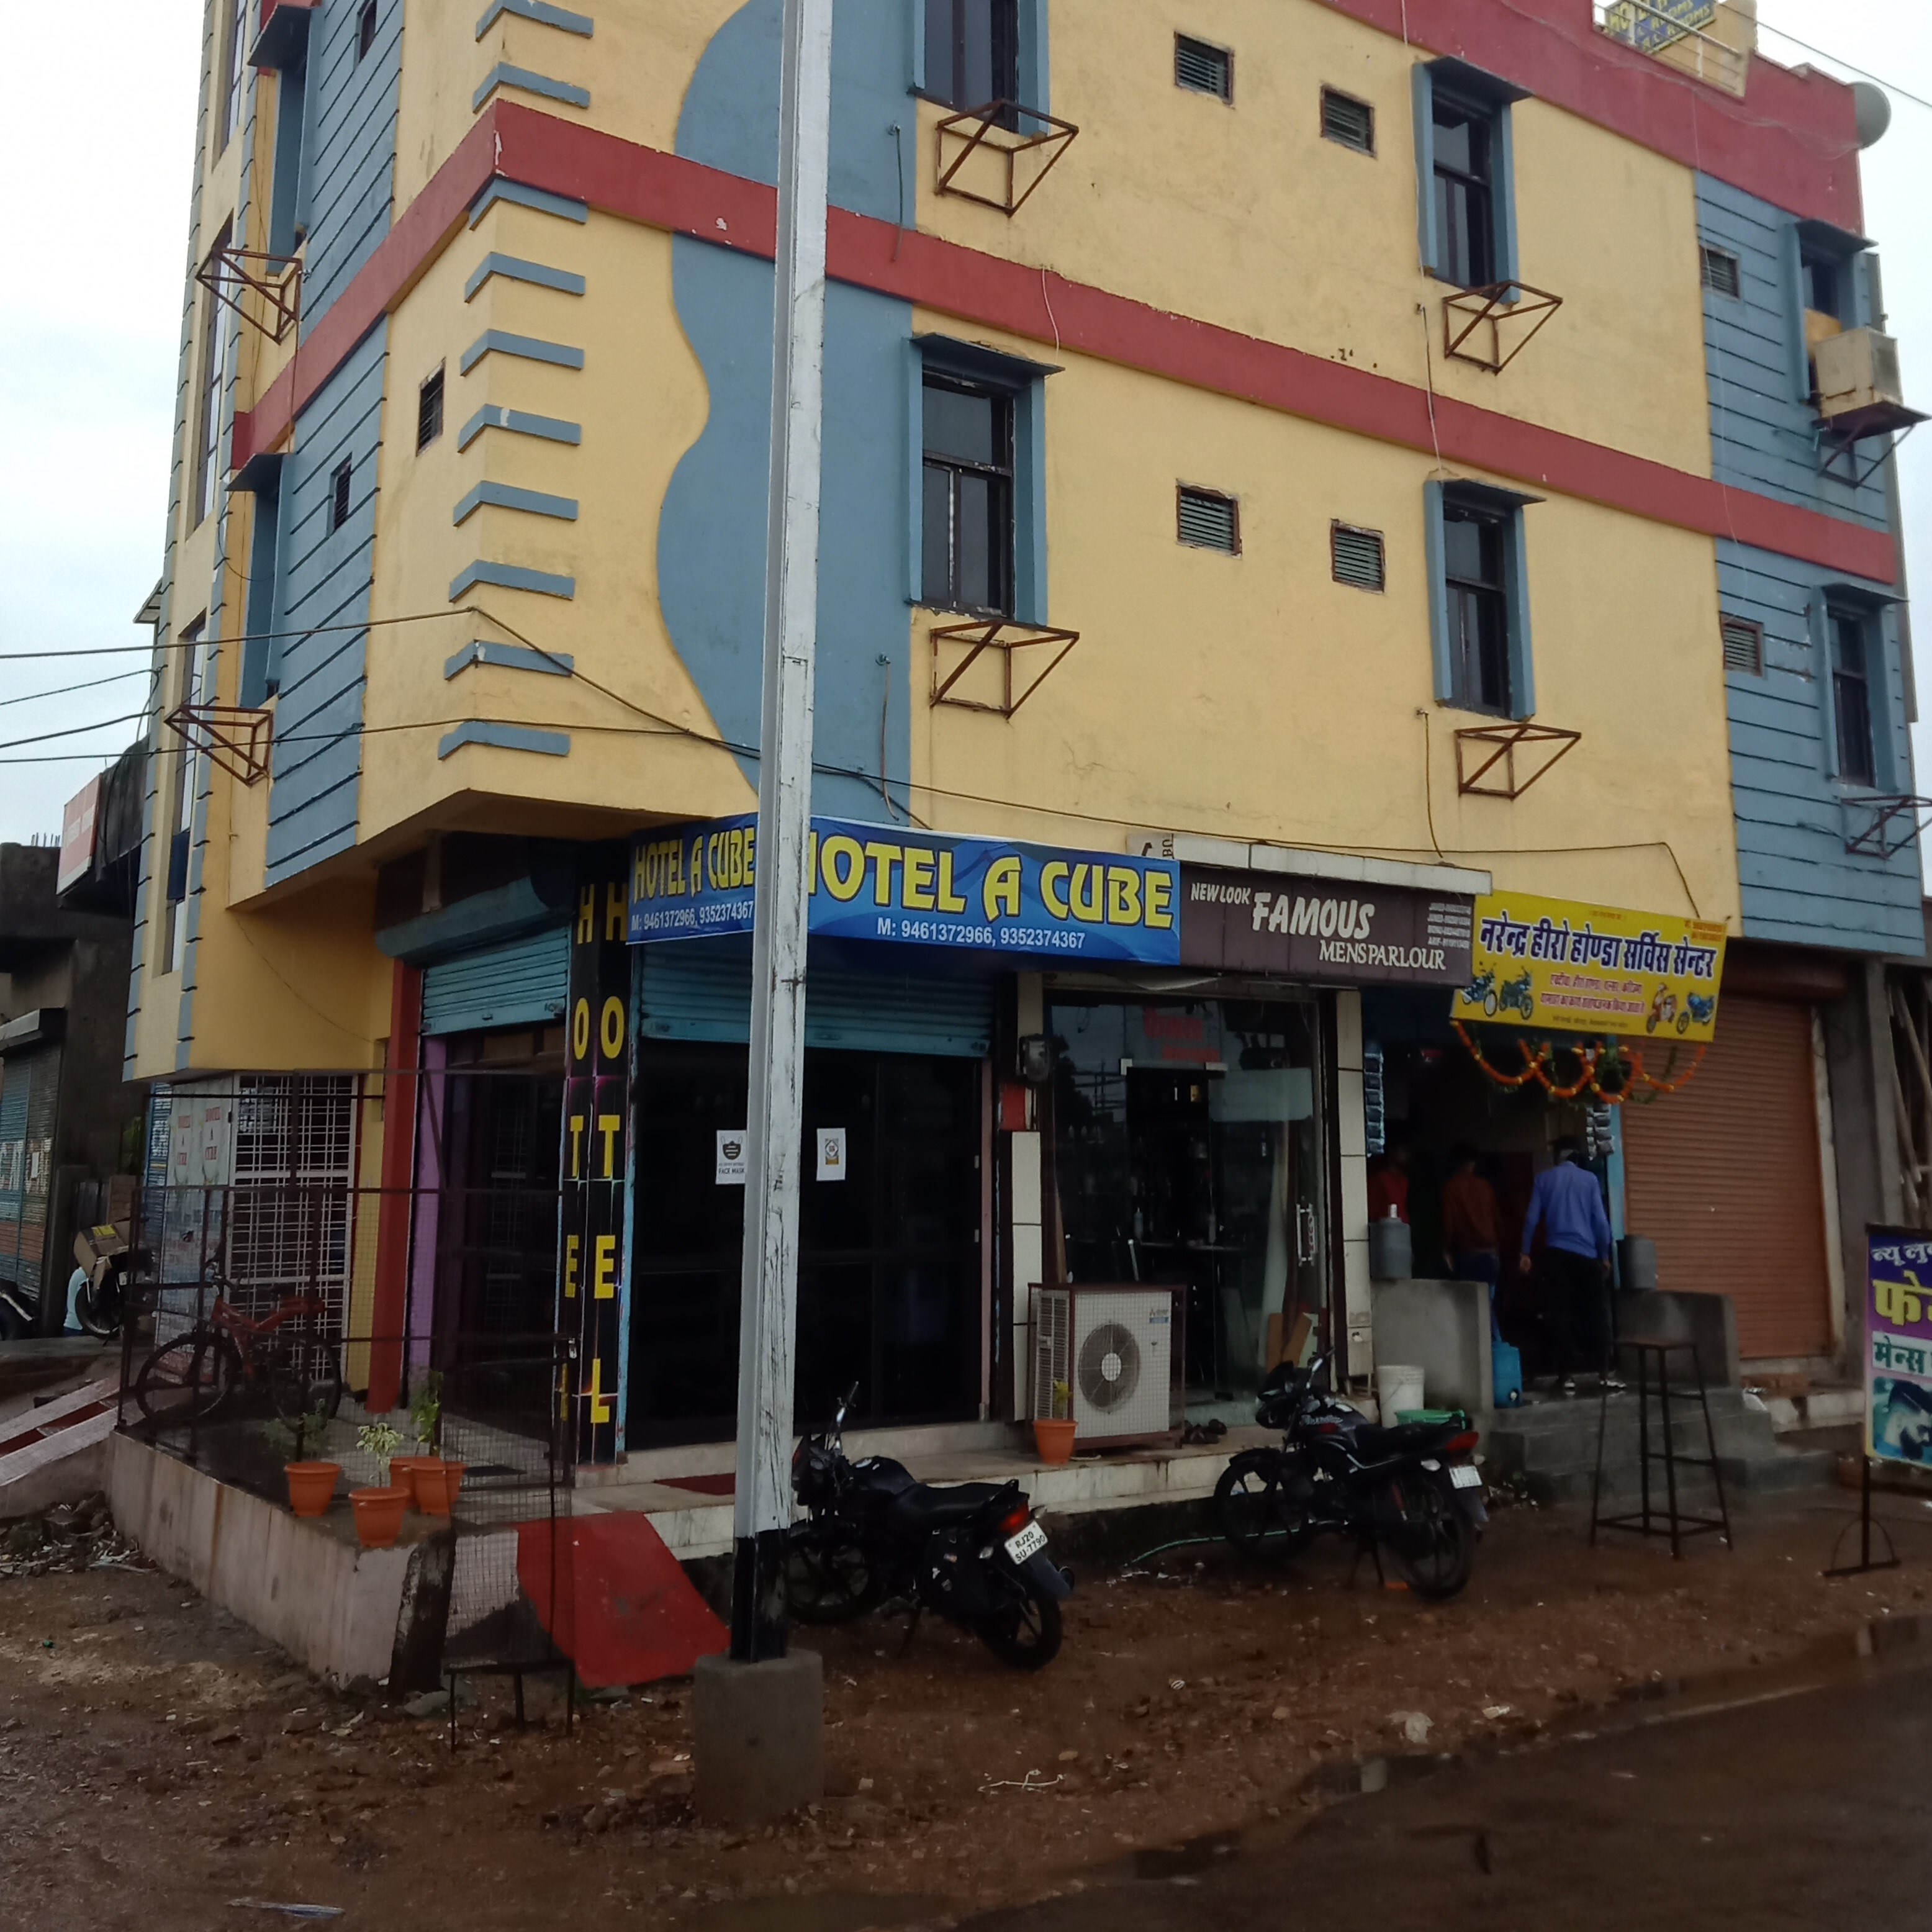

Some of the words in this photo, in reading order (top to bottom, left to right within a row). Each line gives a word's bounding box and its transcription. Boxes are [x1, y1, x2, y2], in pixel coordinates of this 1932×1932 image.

[634, 839, 685, 904] HOTEL
[690, 836, 703, 898] A
[708, 827, 754, 889] CUBE
[983, 855, 1021, 923] A
[1040, 860, 1173, 929] CUBE
[1191, 882, 1220, 902] NEW
[1219, 885, 1251, 905] LOOK
[631, 915, 642, 931] M:
[699, 901, 754, 924] 9352374367
[877, 917, 896, 936] M:
[901, 920, 996, 947] 9461372966,
[1000, 927, 1086, 949] 9352374367
[1252, 892, 1375, 939] FAMOUS
[1368, 944, 1446, 970] PARLOUR
[1481, 911, 1530, 957] नरेन्द्र
[1531, 918, 1569, 961] हीरो
[1571, 923, 1623, 967] होण्डा
[1623, 932, 1672, 973] सर्विस
[1674, 936, 1717, 978] सेन्टर
[1872, 1270, 1932, 1326] फे
[1015, 1531, 1034, 1548] RJ20
